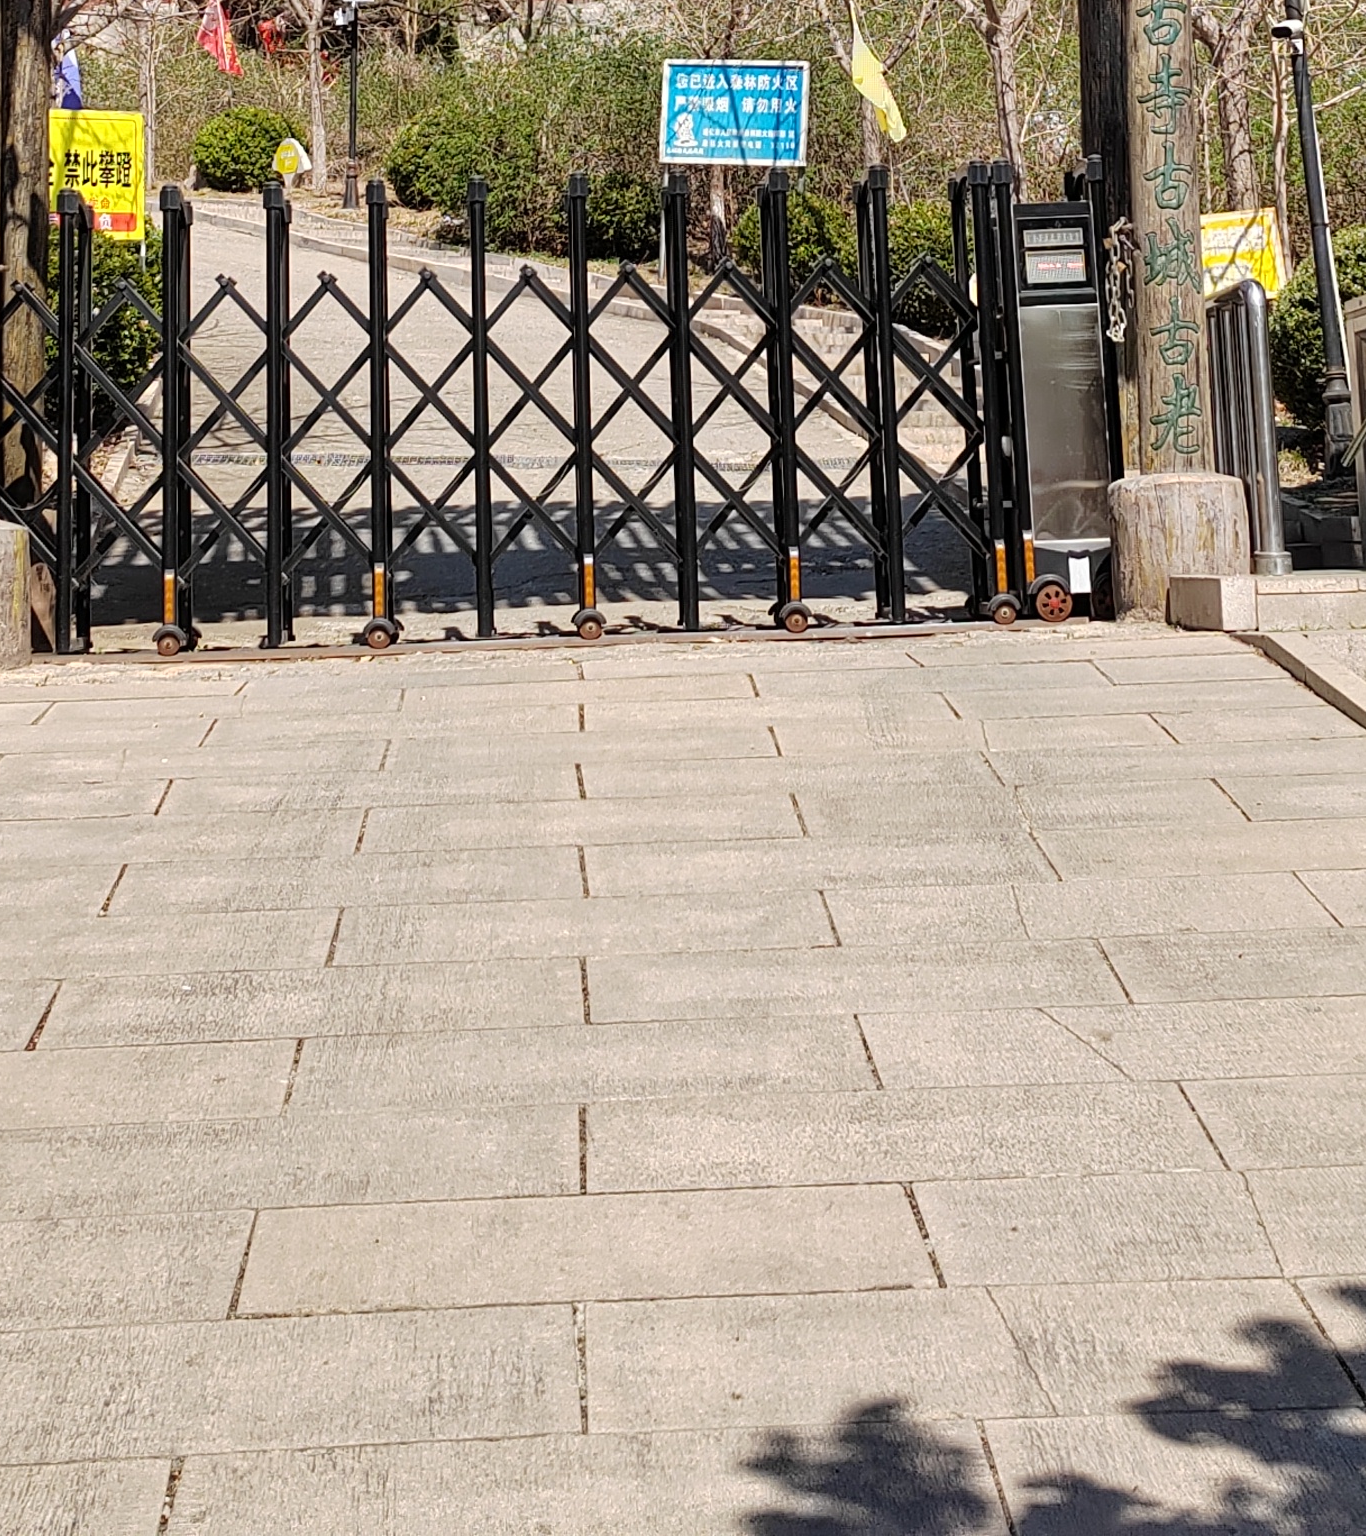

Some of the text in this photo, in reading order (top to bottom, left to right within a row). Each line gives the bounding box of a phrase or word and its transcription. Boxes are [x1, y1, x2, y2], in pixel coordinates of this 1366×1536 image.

[676, 72, 798, 91] 您已进入森林防火区
[742, 96, 797, 114] 请勿用火
